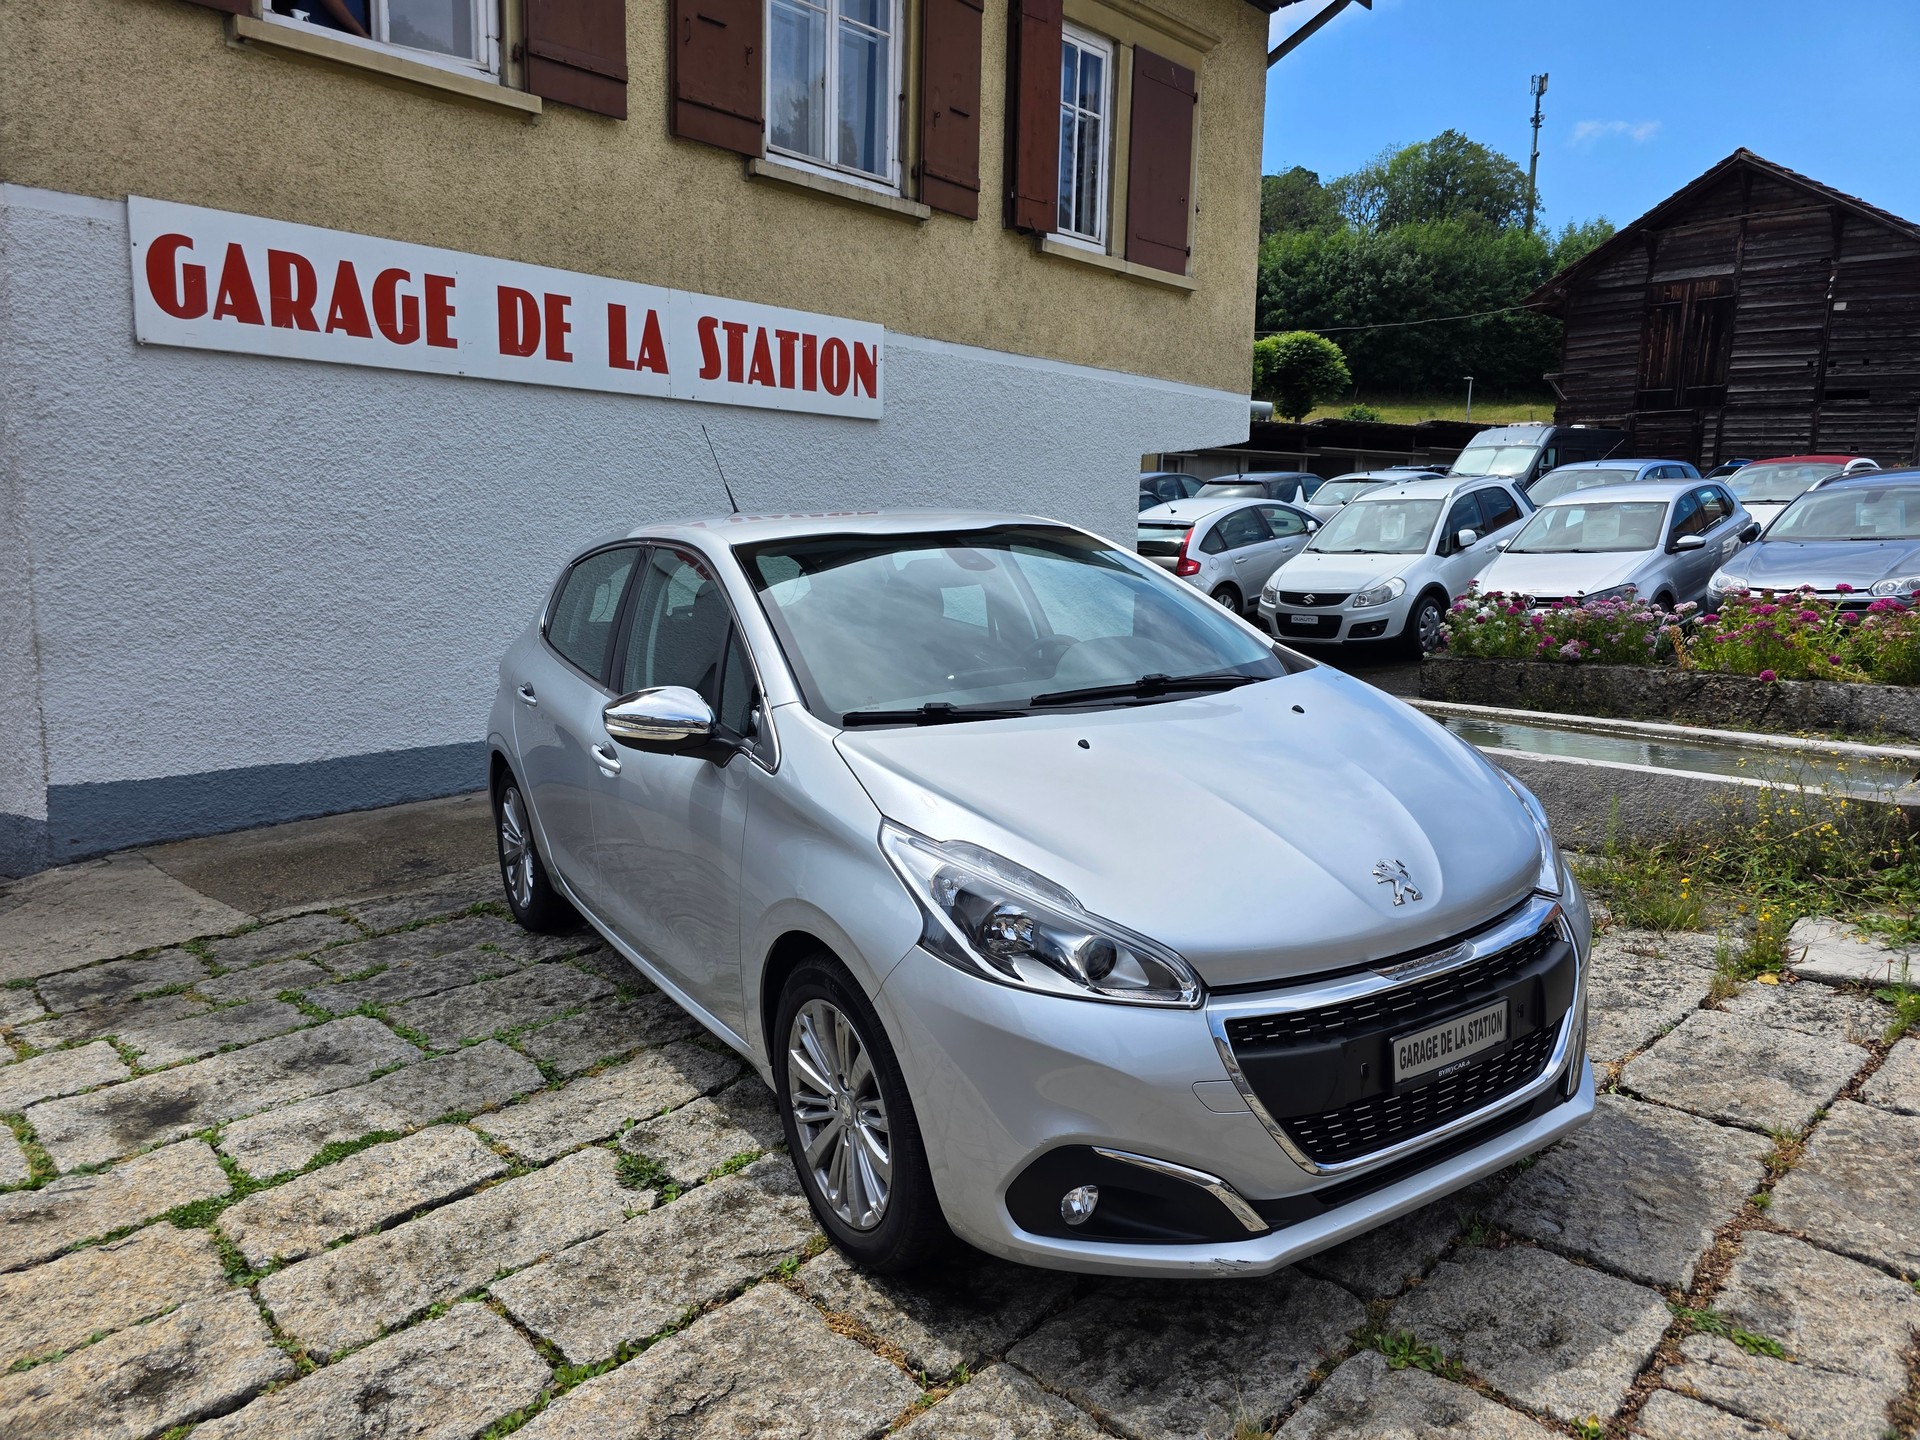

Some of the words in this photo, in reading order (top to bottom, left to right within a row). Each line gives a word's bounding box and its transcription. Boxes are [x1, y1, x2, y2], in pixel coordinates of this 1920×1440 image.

[146, 233, 458, 349] GARAGE
[497, 285, 573, 363] DE
[608, 303, 669, 375] LA
[697, 315, 878, 399] STATION
[1400, 1035, 1438, 1070] GARAGE
[1441, 1029, 1452, 1055] DE
[1455, 1025, 1466, 1050] LA
[1468, 1010, 1502, 1044] STATION
